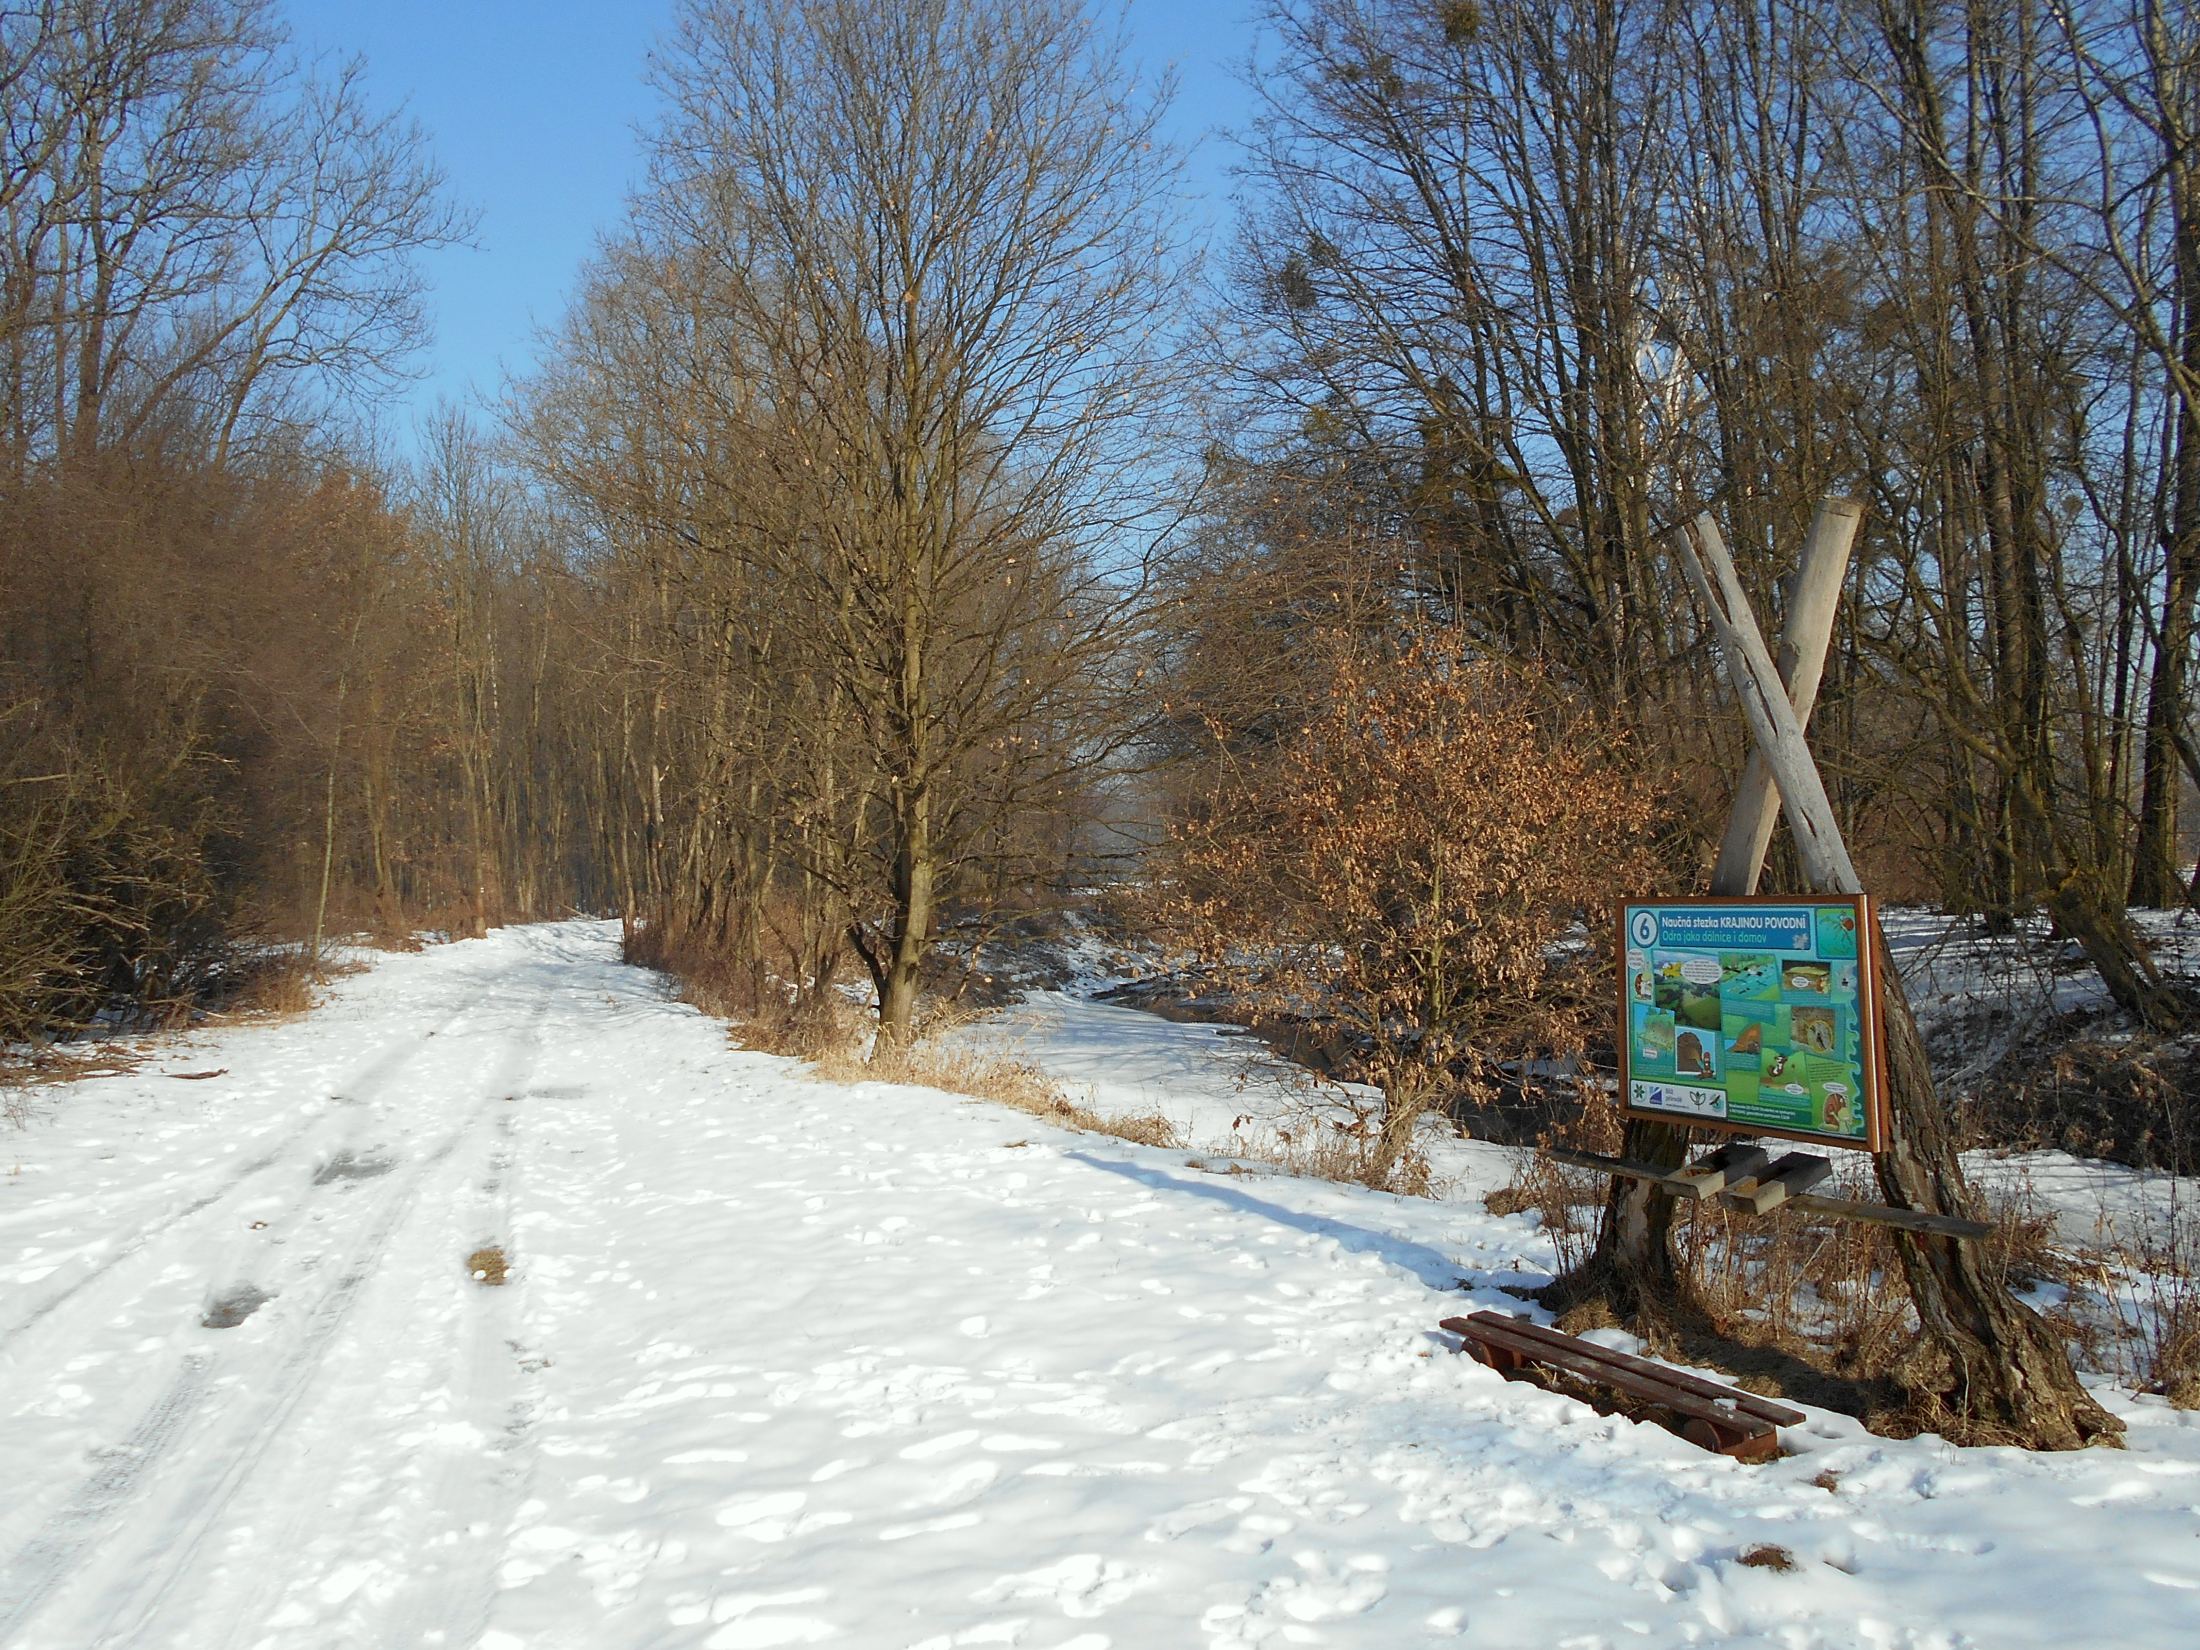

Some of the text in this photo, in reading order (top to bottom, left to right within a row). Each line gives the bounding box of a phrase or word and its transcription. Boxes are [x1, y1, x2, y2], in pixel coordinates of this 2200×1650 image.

[1639, 918, 1650, 939] 6
[1662, 914, 1806, 929] Naučná stezka KRAJINOU POVODNÍ
[1662, 931, 1682, 942] Odra
[1683, 931, 1700, 943] jako
[1739, 932, 1767, 943] domov
